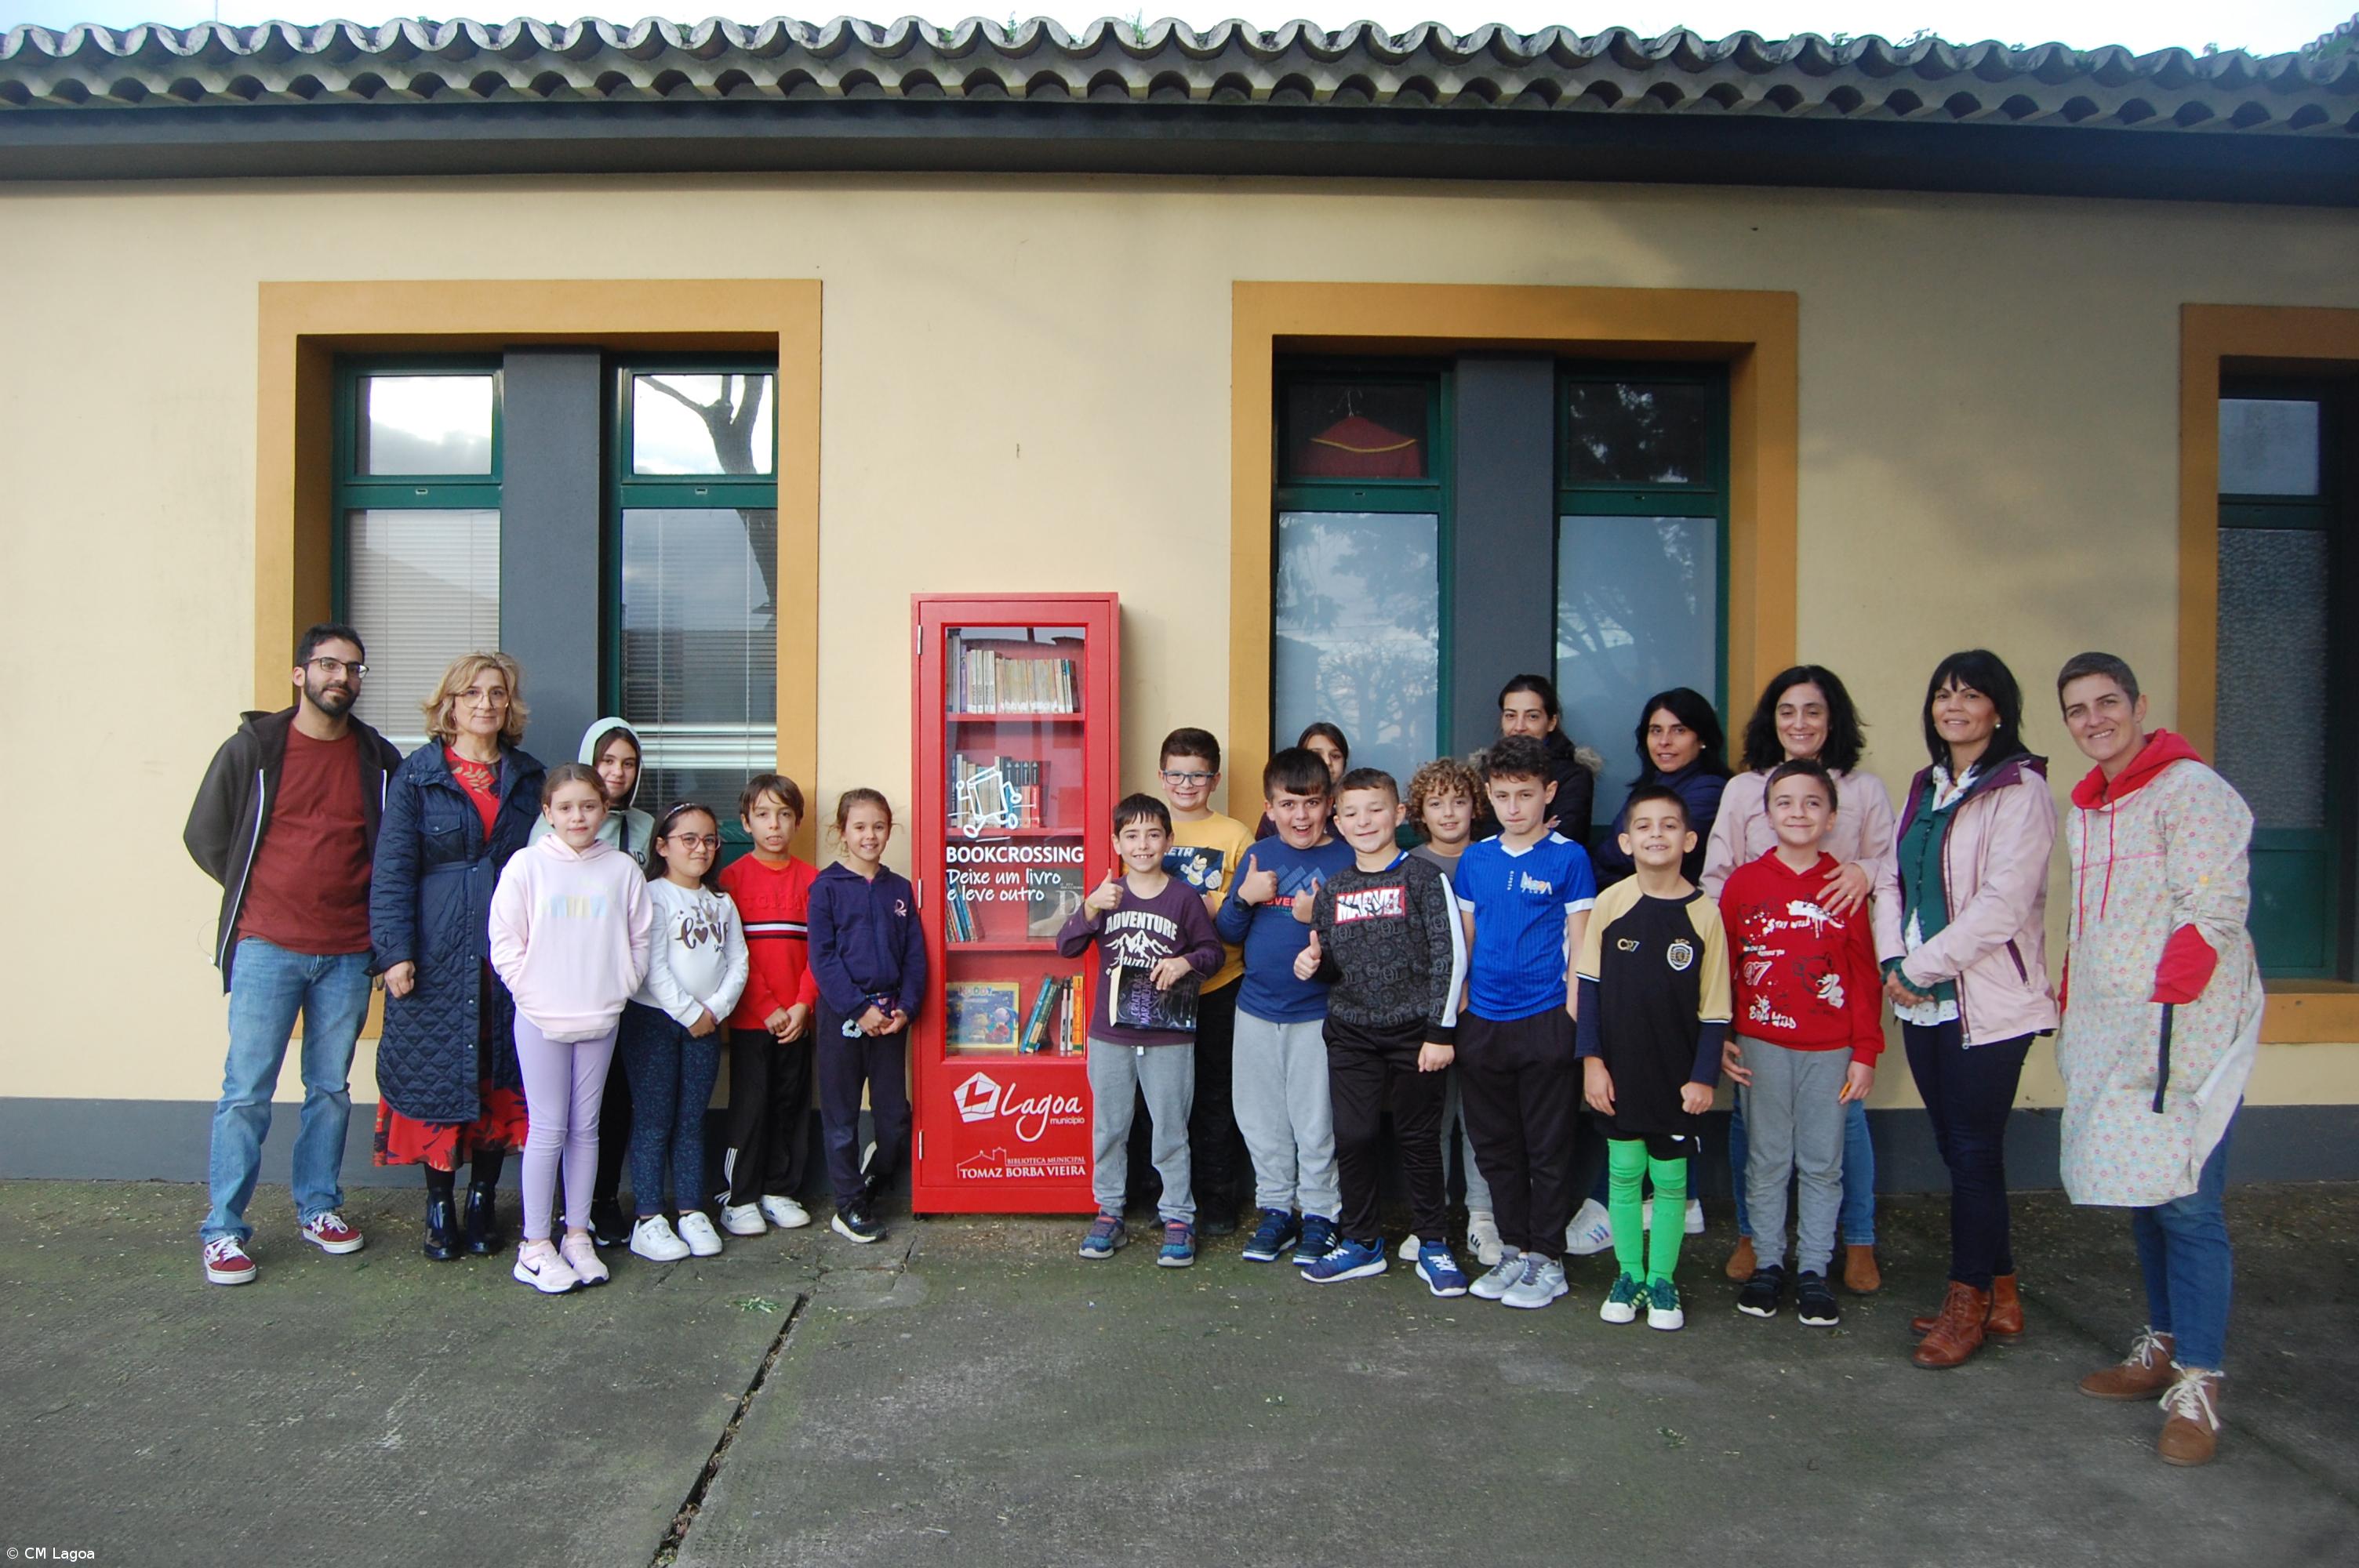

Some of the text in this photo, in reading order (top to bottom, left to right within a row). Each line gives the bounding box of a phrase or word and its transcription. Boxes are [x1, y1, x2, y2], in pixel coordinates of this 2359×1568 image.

[946, 846, 1084, 862] BOOKCROSSING
[1164, 847, 1194, 857] ETA
[946, 868, 1061, 884] Deixe um livro
[947, 885, 1045, 902] e leve outro
[1336, 888, 1402, 922] MARVEL
[1104, 911, 1179, 941] ADVENTURE
[1001, 1083, 1083, 1142] Lagoa
[960, 1166, 1086, 1179] TOMAZ BORBA VIEIRA
